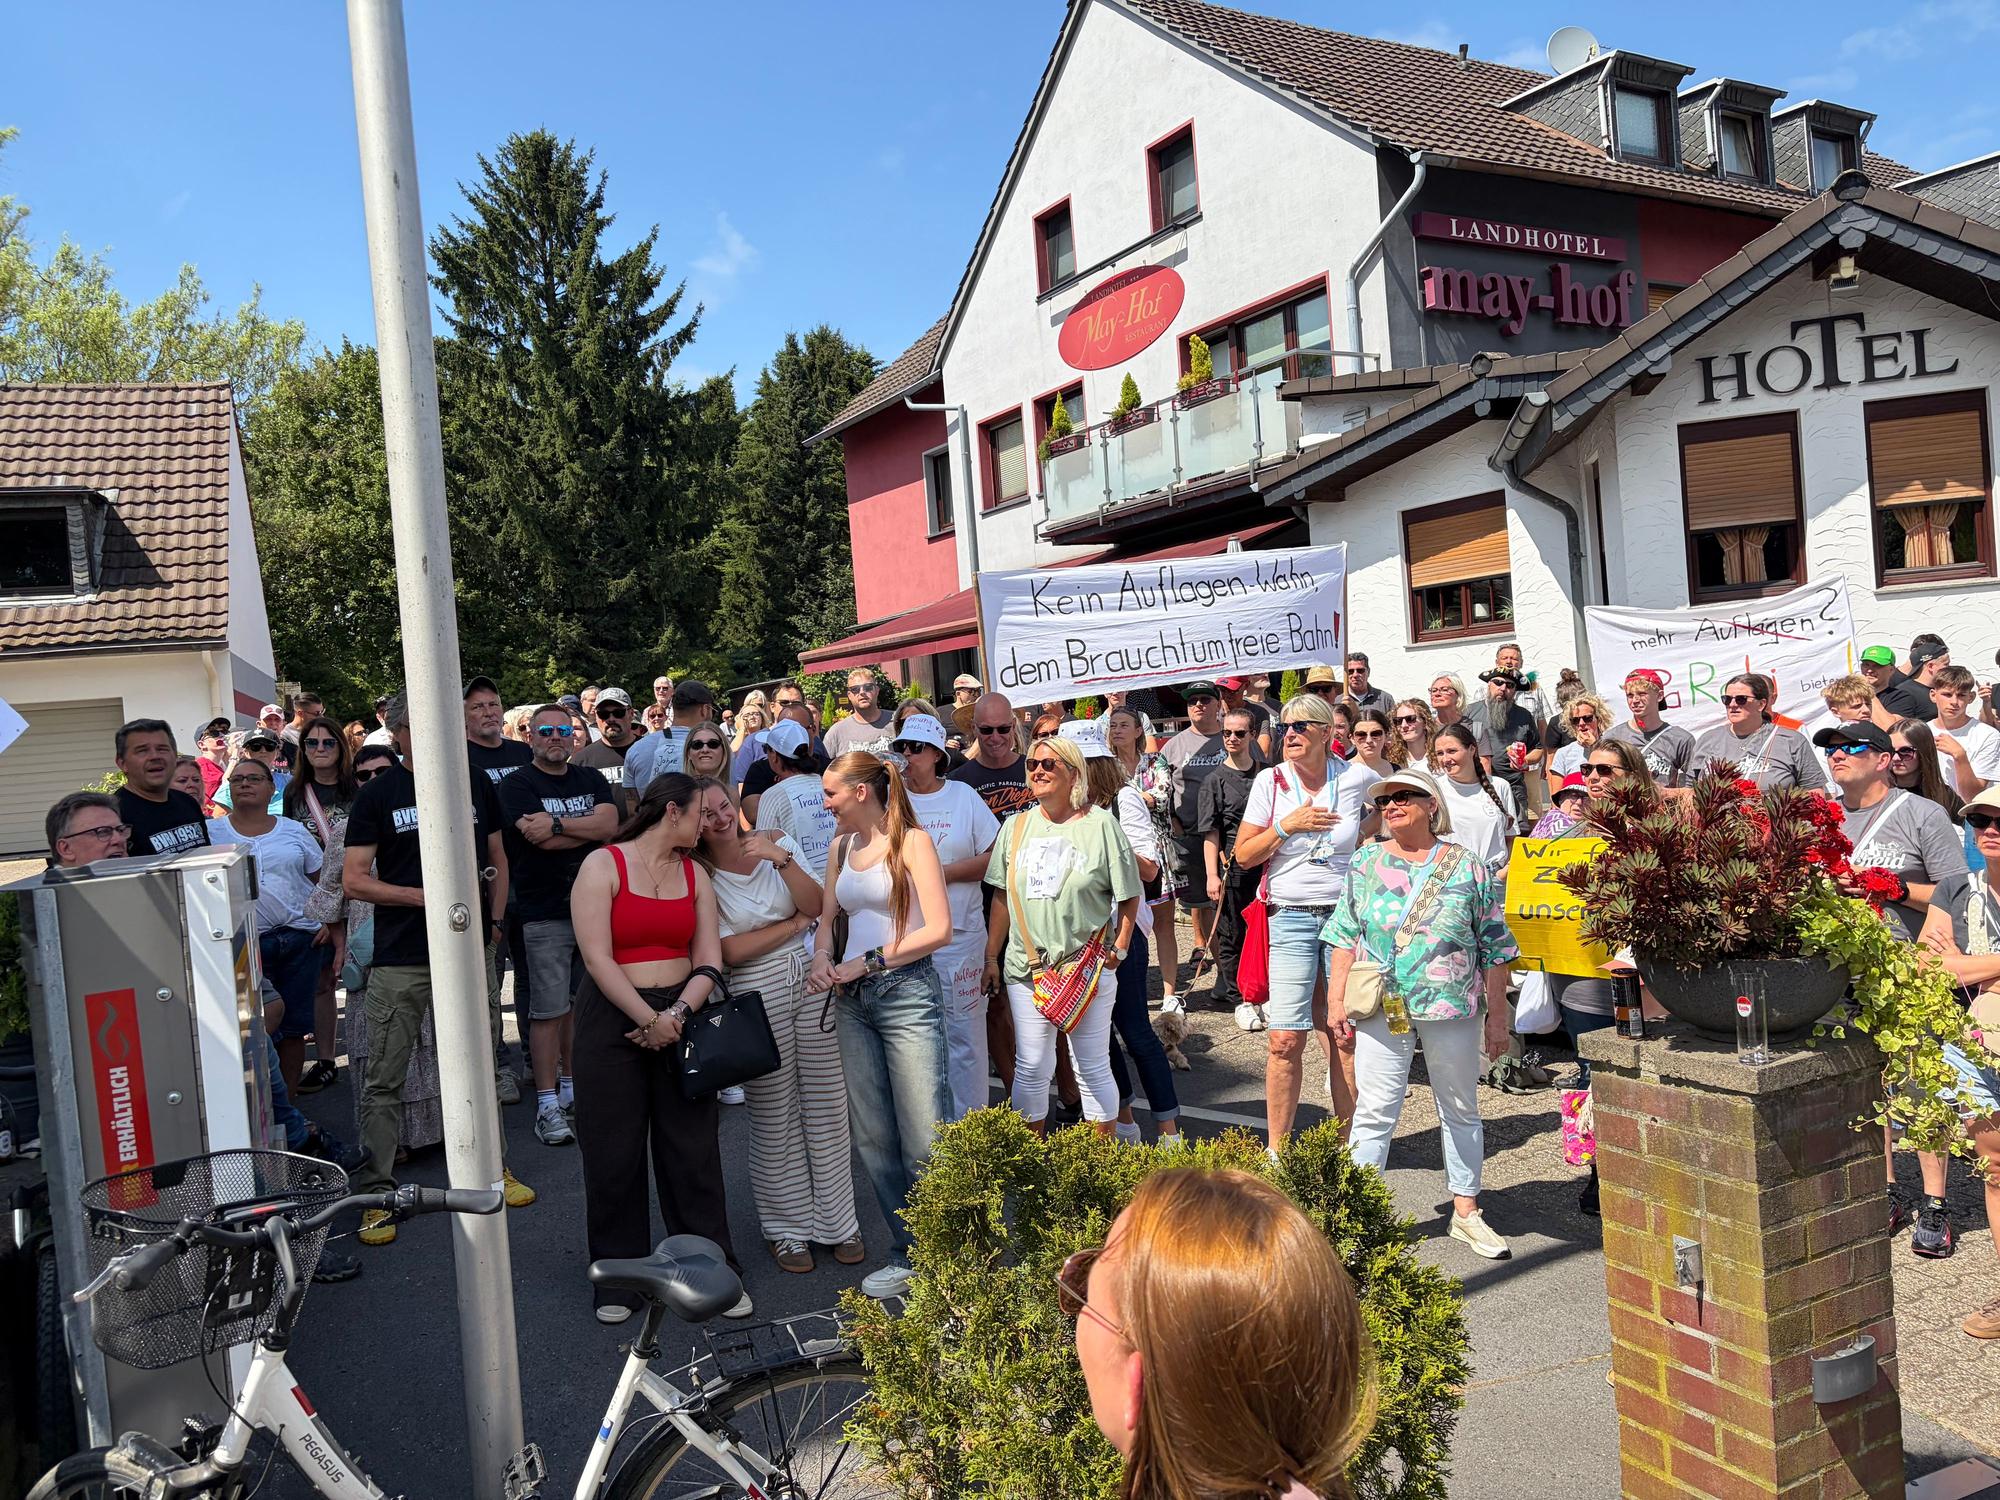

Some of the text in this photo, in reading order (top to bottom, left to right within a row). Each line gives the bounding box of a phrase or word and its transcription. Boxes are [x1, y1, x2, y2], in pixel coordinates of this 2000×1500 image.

[1450, 218, 1606, 257] LANDHOTEL
[1090, 279, 1127, 303] LANDHOTEL
[1420, 262, 1637, 336] may-hof
[1068, 282, 1172, 367] May-Hof
[1125, 318, 1168, 343] RESTAURANT
[1694, 311, 1960, 405] HOTEL
[1029, 577, 1104, 618] Kein
[1000, 610, 1341, 688] dem Brauchtum freie Bahn!
[1631, 628, 1676, 651] mehr
[1522, 842, 1569, 859] Wir
[108, 1066, 138, 1162] ERHÄLTLICH
[298, 1432, 345, 1484] PEGASUS
